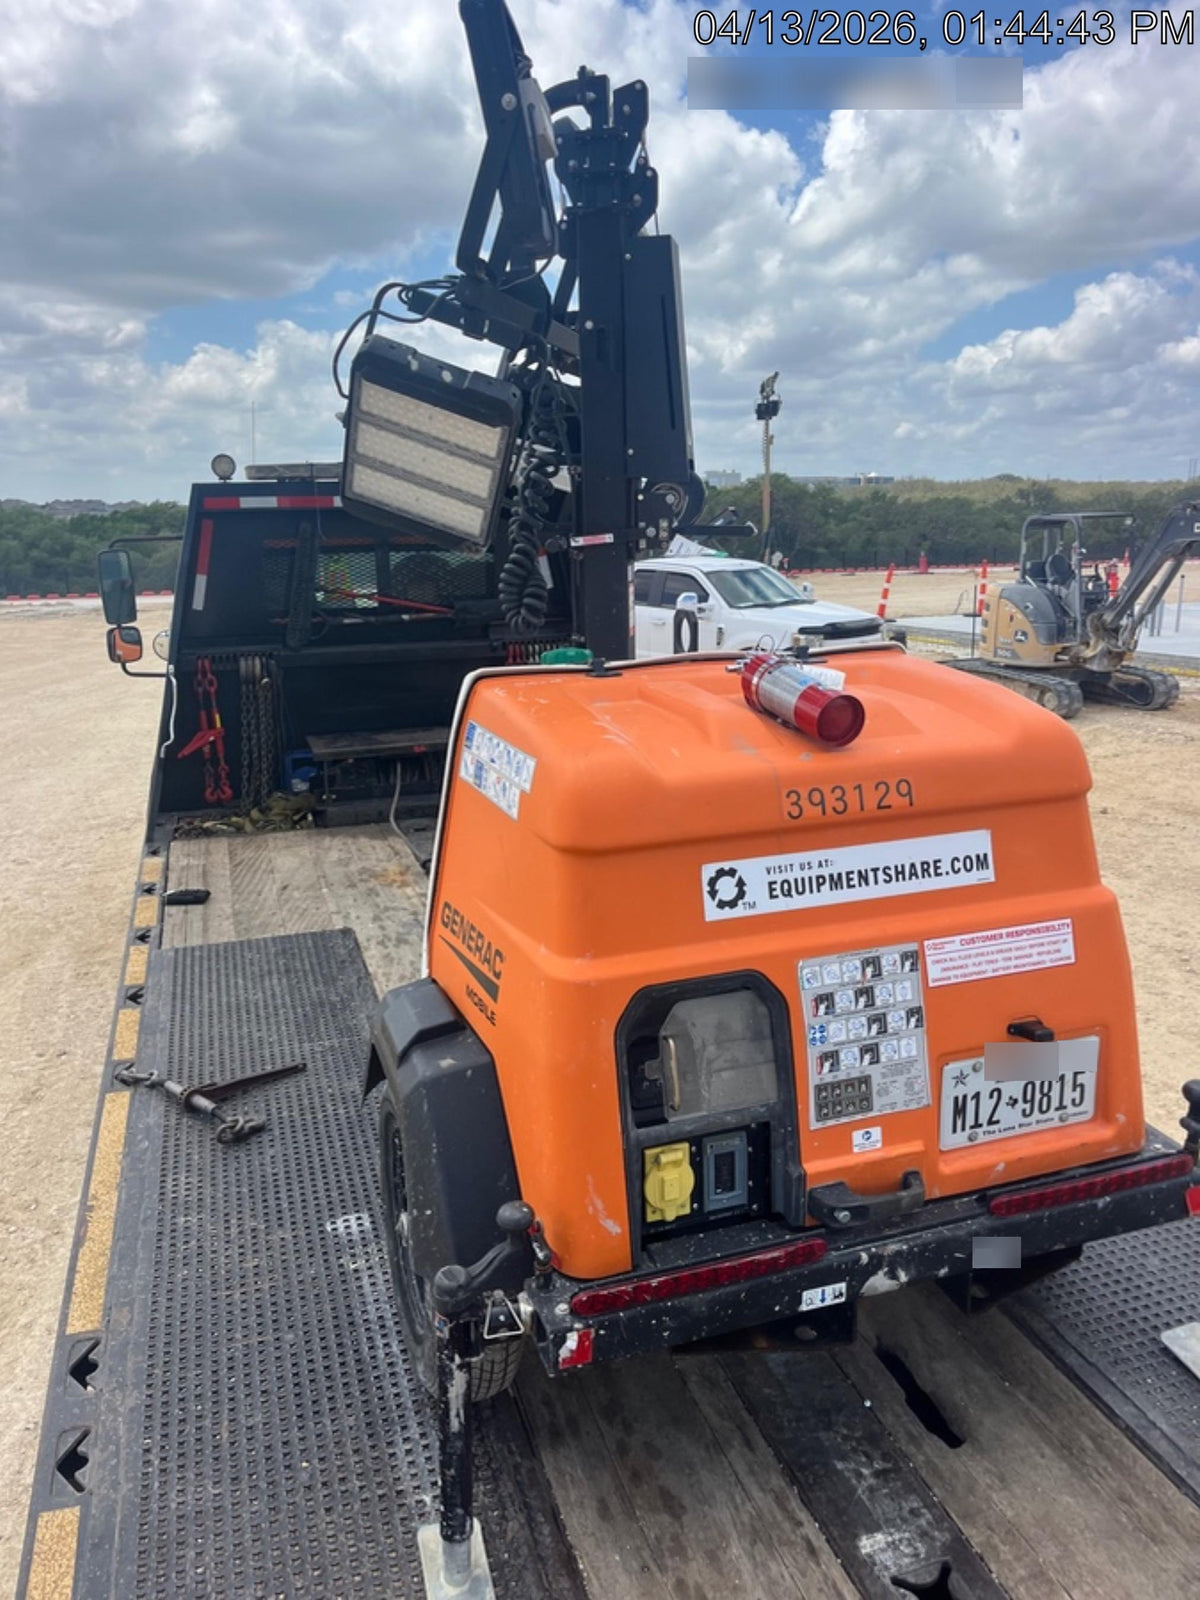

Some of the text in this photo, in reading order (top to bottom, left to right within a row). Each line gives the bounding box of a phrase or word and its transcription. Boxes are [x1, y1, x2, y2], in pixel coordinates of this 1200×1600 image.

[785, 778, 914, 820] 393129
[766, 859, 833, 875] VISIT US AT:
[768, 853, 990, 900] EQUIPMENTSHARE.COM
[440, 901, 504, 980] GENERAC
[960, 933, 1004, 946] CUSTOMER
[465, 984, 496, 1026] MOBILE
[951, 1071, 1086, 1134] M12 9815
